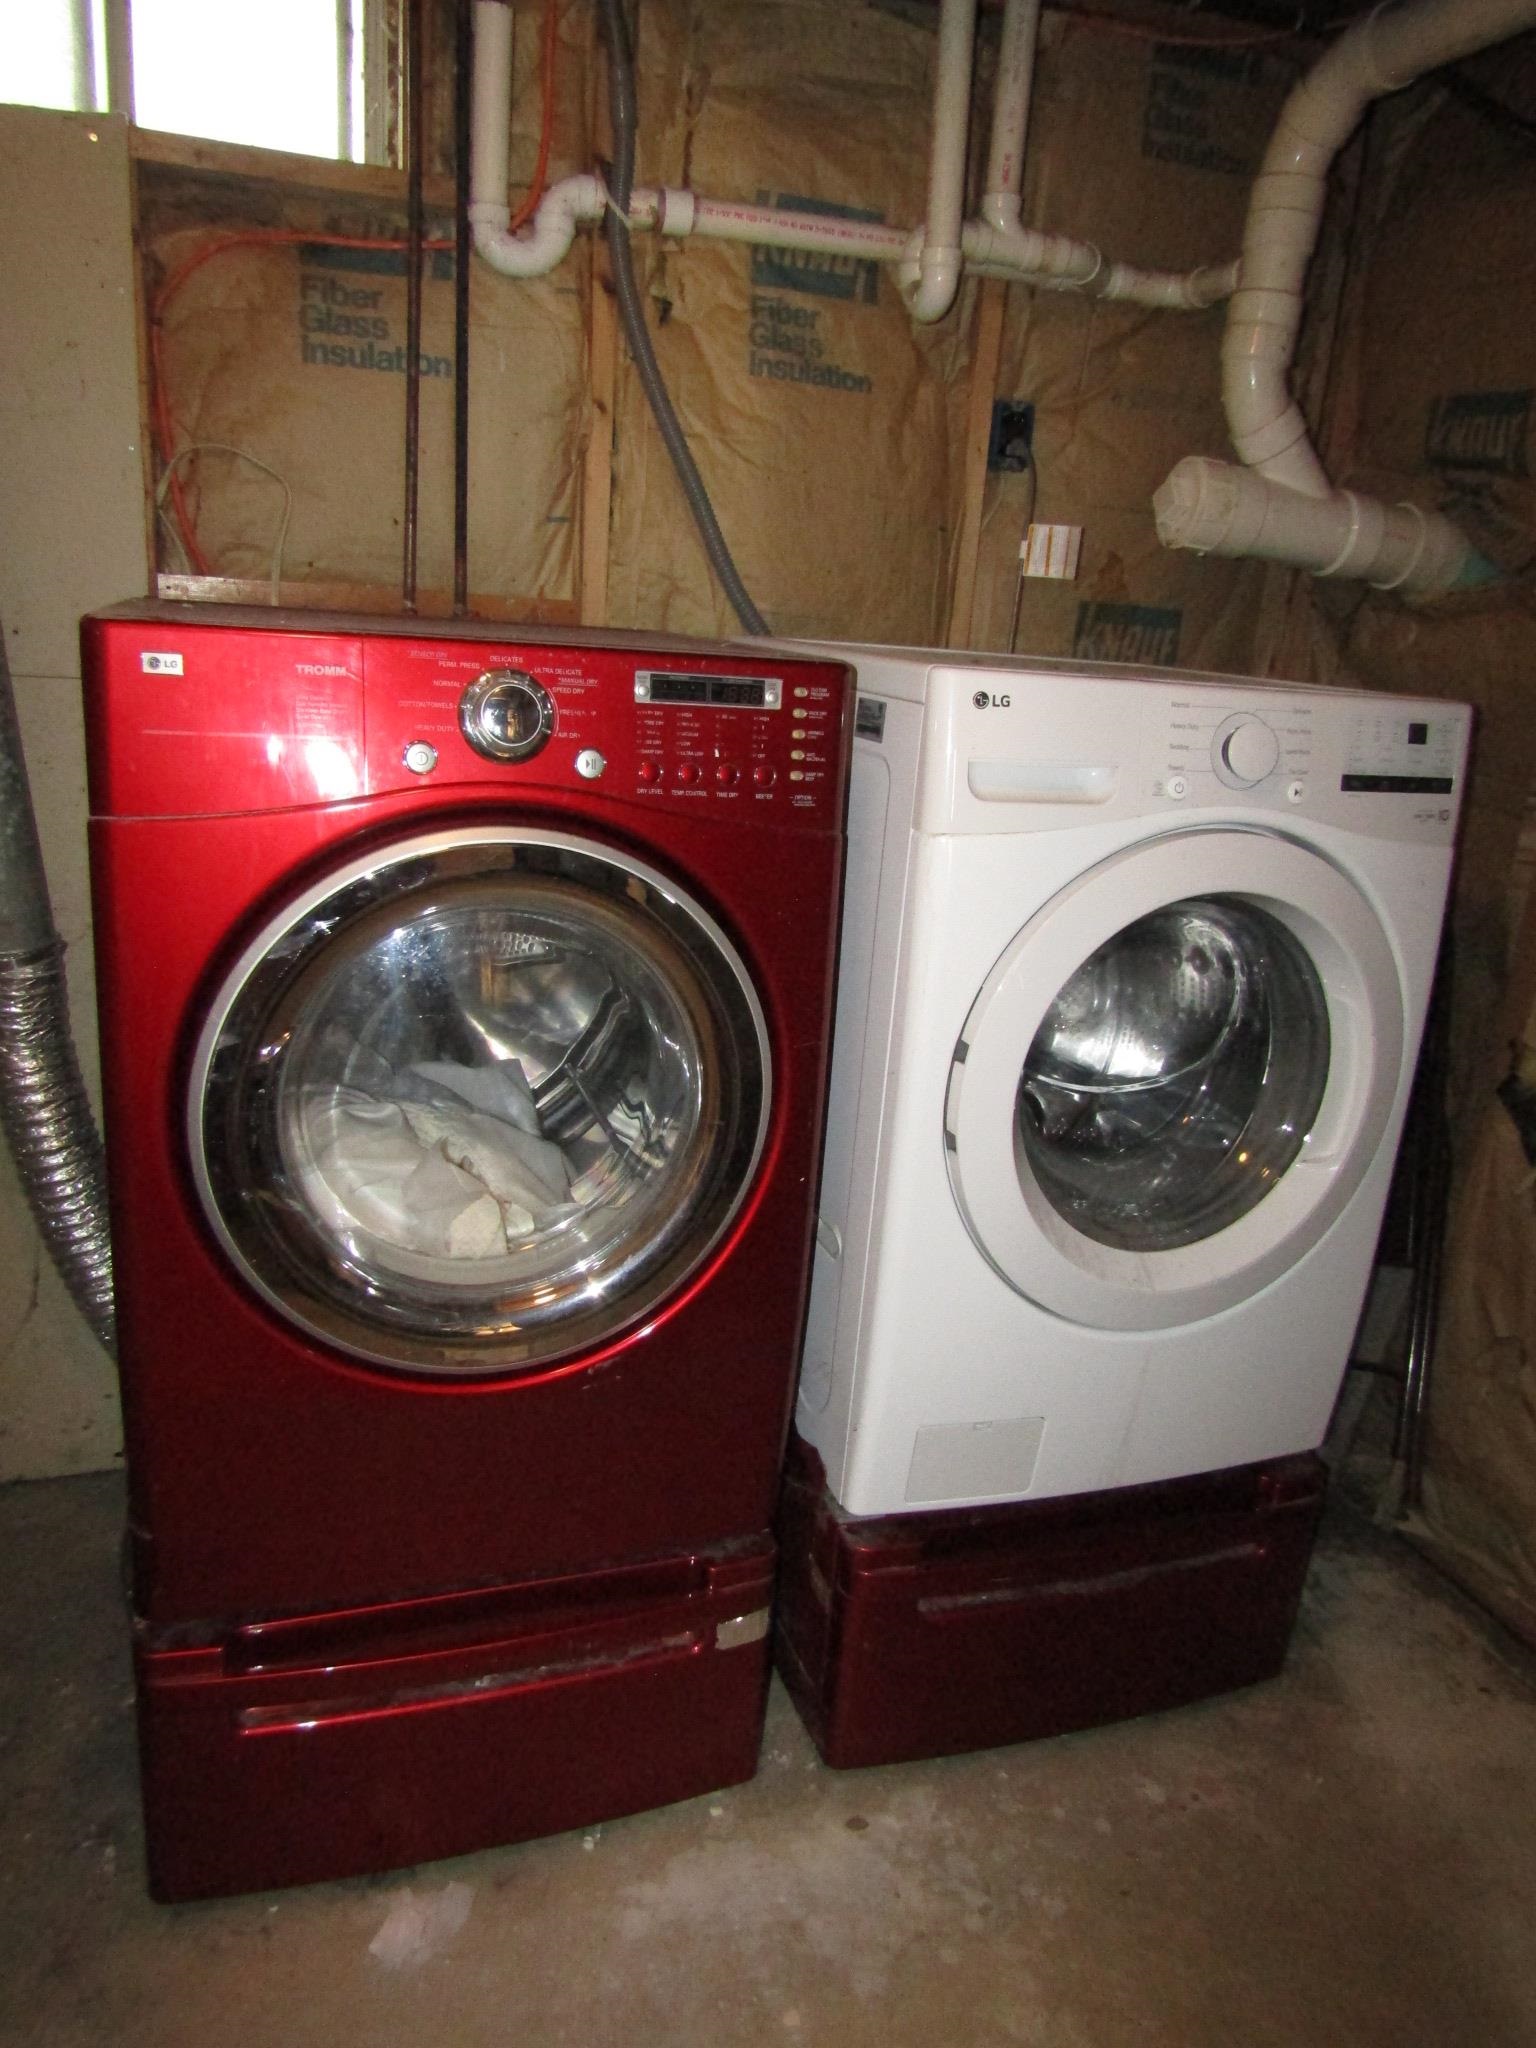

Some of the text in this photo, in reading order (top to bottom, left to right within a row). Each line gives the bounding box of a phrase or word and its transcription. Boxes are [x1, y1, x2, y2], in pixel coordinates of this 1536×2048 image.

[302, 273, 383, 309] Fiber
[300, 303, 390, 340] Glass
[751, 294, 820, 329] Fiber
[749, 321, 824, 358] Glass
[302, 334, 452, 378] Insulaton
[749, 350, 873, 394] Insulation
[295, 664, 347, 676] TROMM
[490, 655, 523, 663] DELICATES
[433, 679, 461, 688] NORMAL
[554, 668, 582, 676] DELICATE
[552, 686, 585, 695] SPEED DRY
[991, 695, 1011, 708] LG
